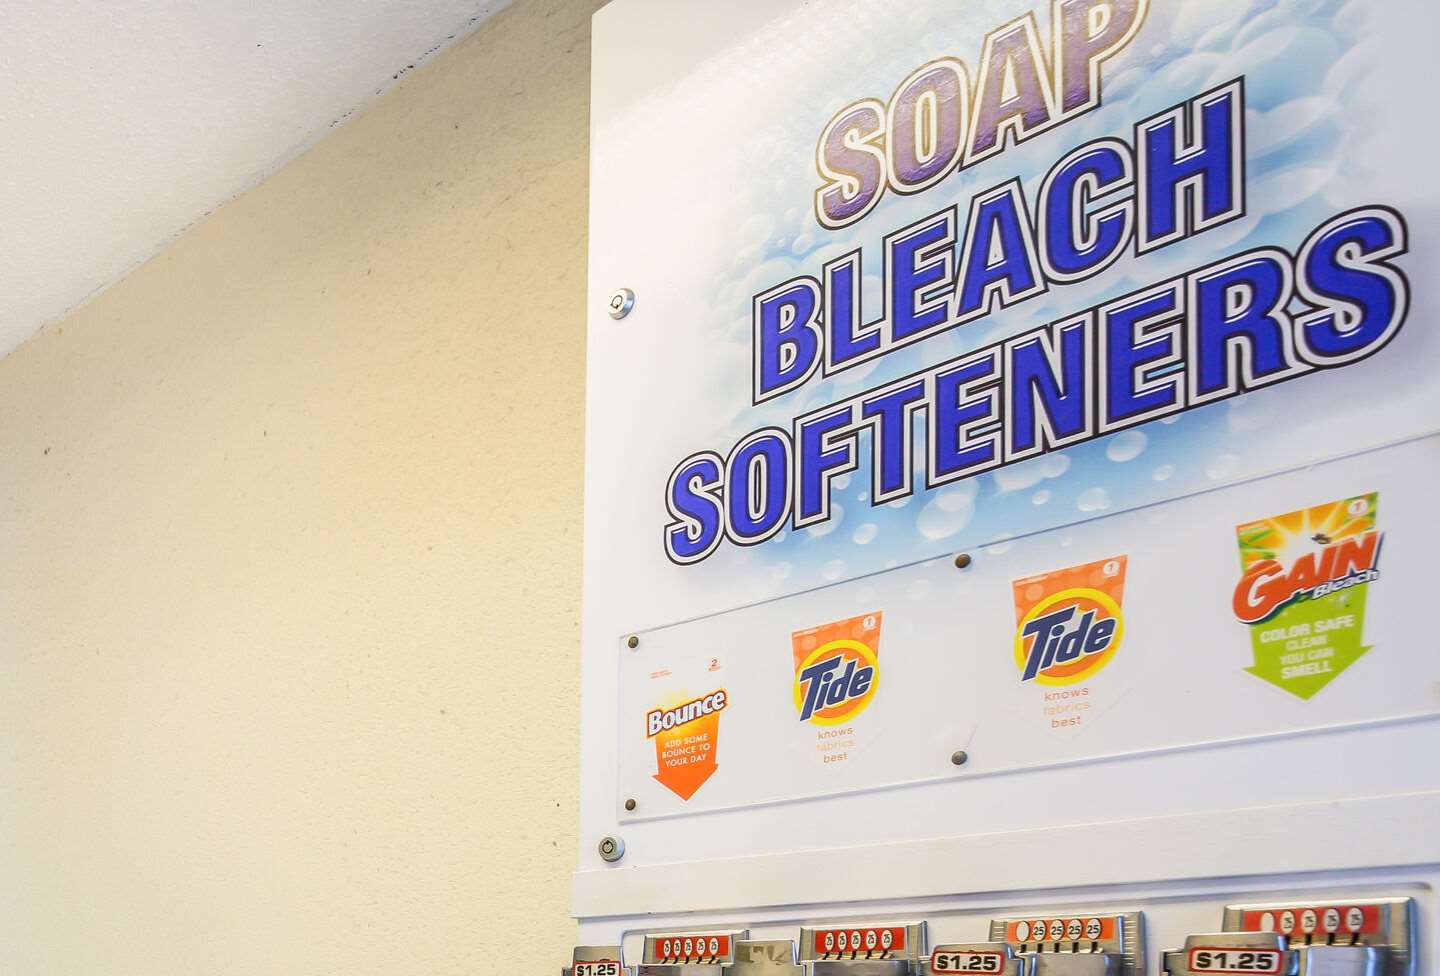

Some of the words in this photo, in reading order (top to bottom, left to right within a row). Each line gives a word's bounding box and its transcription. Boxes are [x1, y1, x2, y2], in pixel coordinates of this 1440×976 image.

[814, 0, 1146, 231] SOAP
[752, 75, 1246, 405] BLEACH
[664, 205, 1410, 566] SOFTENERS
[1232, 530, 1382, 624] GAIN
[1313, 569, 1381, 601] Bleach
[1260, 623, 1312, 643] COLOR
[1314, 615, 1355, 634] SAFE
[1021, 605, 1117, 682] Tide
[1285, 635, 1328, 652] CLEAN
[1279, 652, 1305, 666] YOU
[1307, 647, 1335, 661] CAN
[1281, 660, 1333, 680] SMELL
[799, 655, 874, 722] Tide
[1044, 687, 1089, 702] knows
[647, 690, 727, 738] Bounce
[1043, 701, 1090, 715] fabrics
[1051, 716, 1081, 729] best
[665, 739, 680, 748] ADD
[683, 734, 709, 744] SOME
[817, 727, 854, 740] knows
[662, 746, 697, 758] BOUNCE
[699, 743, 711, 751] TO
[816, 739, 856, 752] fabrics
[665, 758, 688, 768] YOUR
[691, 753, 707, 763] DAY
[823, 752, 849, 764] best
[1033, 926, 1044, 936] 25
[1051, 925, 1062, 935] 25
[1068, 925, 1081, 935] 25
[1087, 924, 1099, 934] 25
[576, 963, 616, 976] $1.25
[936, 955, 996, 971] $1.25
[1195, 951, 1273, 971] $1.25
